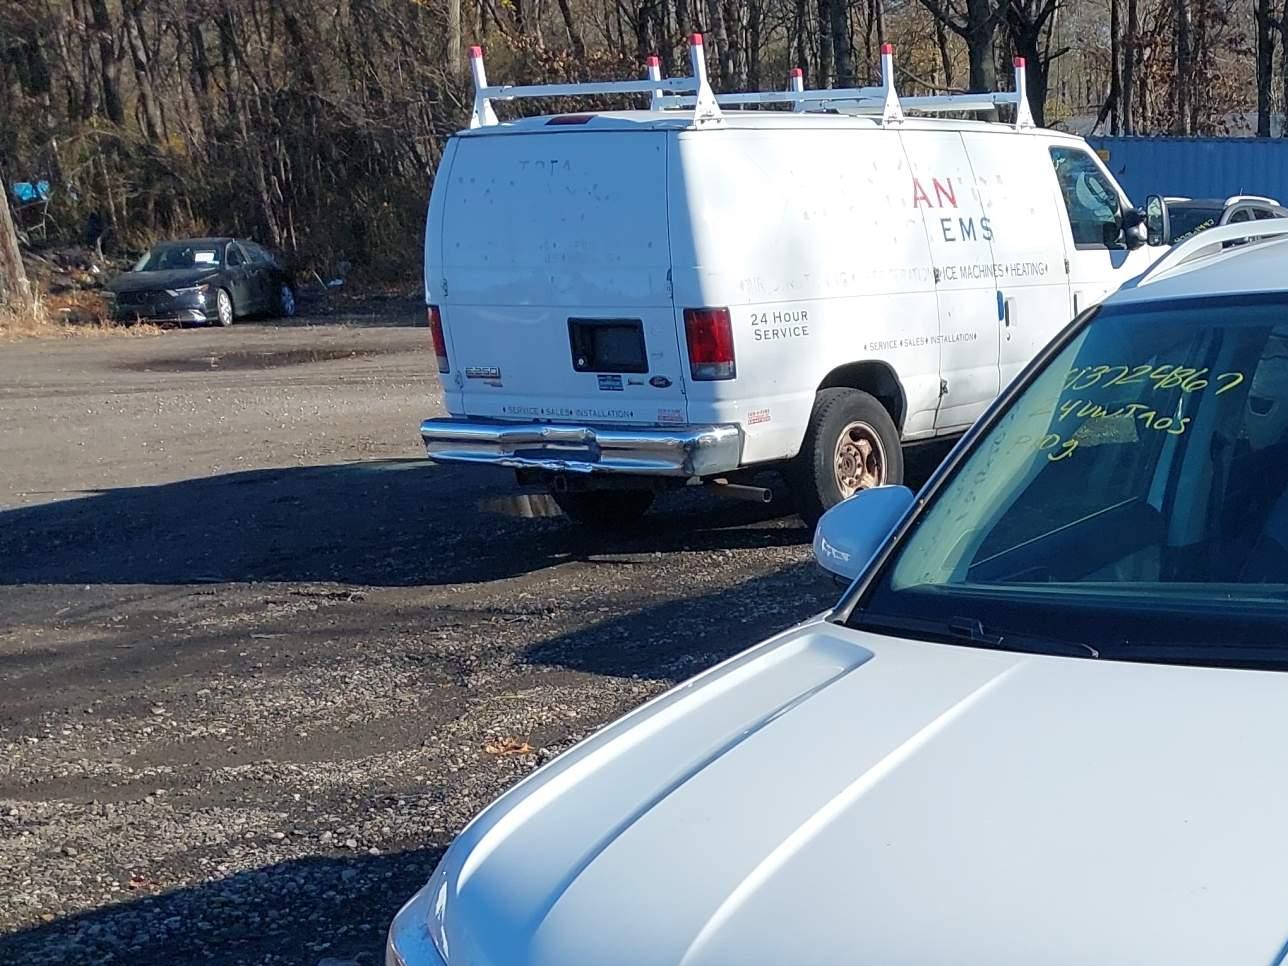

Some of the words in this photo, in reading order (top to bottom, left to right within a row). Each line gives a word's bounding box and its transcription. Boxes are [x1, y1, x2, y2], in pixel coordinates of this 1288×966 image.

[959, 263, 1004, 280] MACHINES
[1010, 262, 1044, 277] HEATING
[751, 313, 768, 327] 24
[773, 310, 808, 325] HOUR
[754, 326, 809, 341] SERVICE
[869, 339, 898, 351] SERVICE
[904, 337, 925, 348] SALES
[930, 333, 974, 345] INSTALLATION
[506, 406, 540, 415] SERVICE
[546, 407, 570, 416] SALES
[575, 409, 630, 418] INSTALLATION
